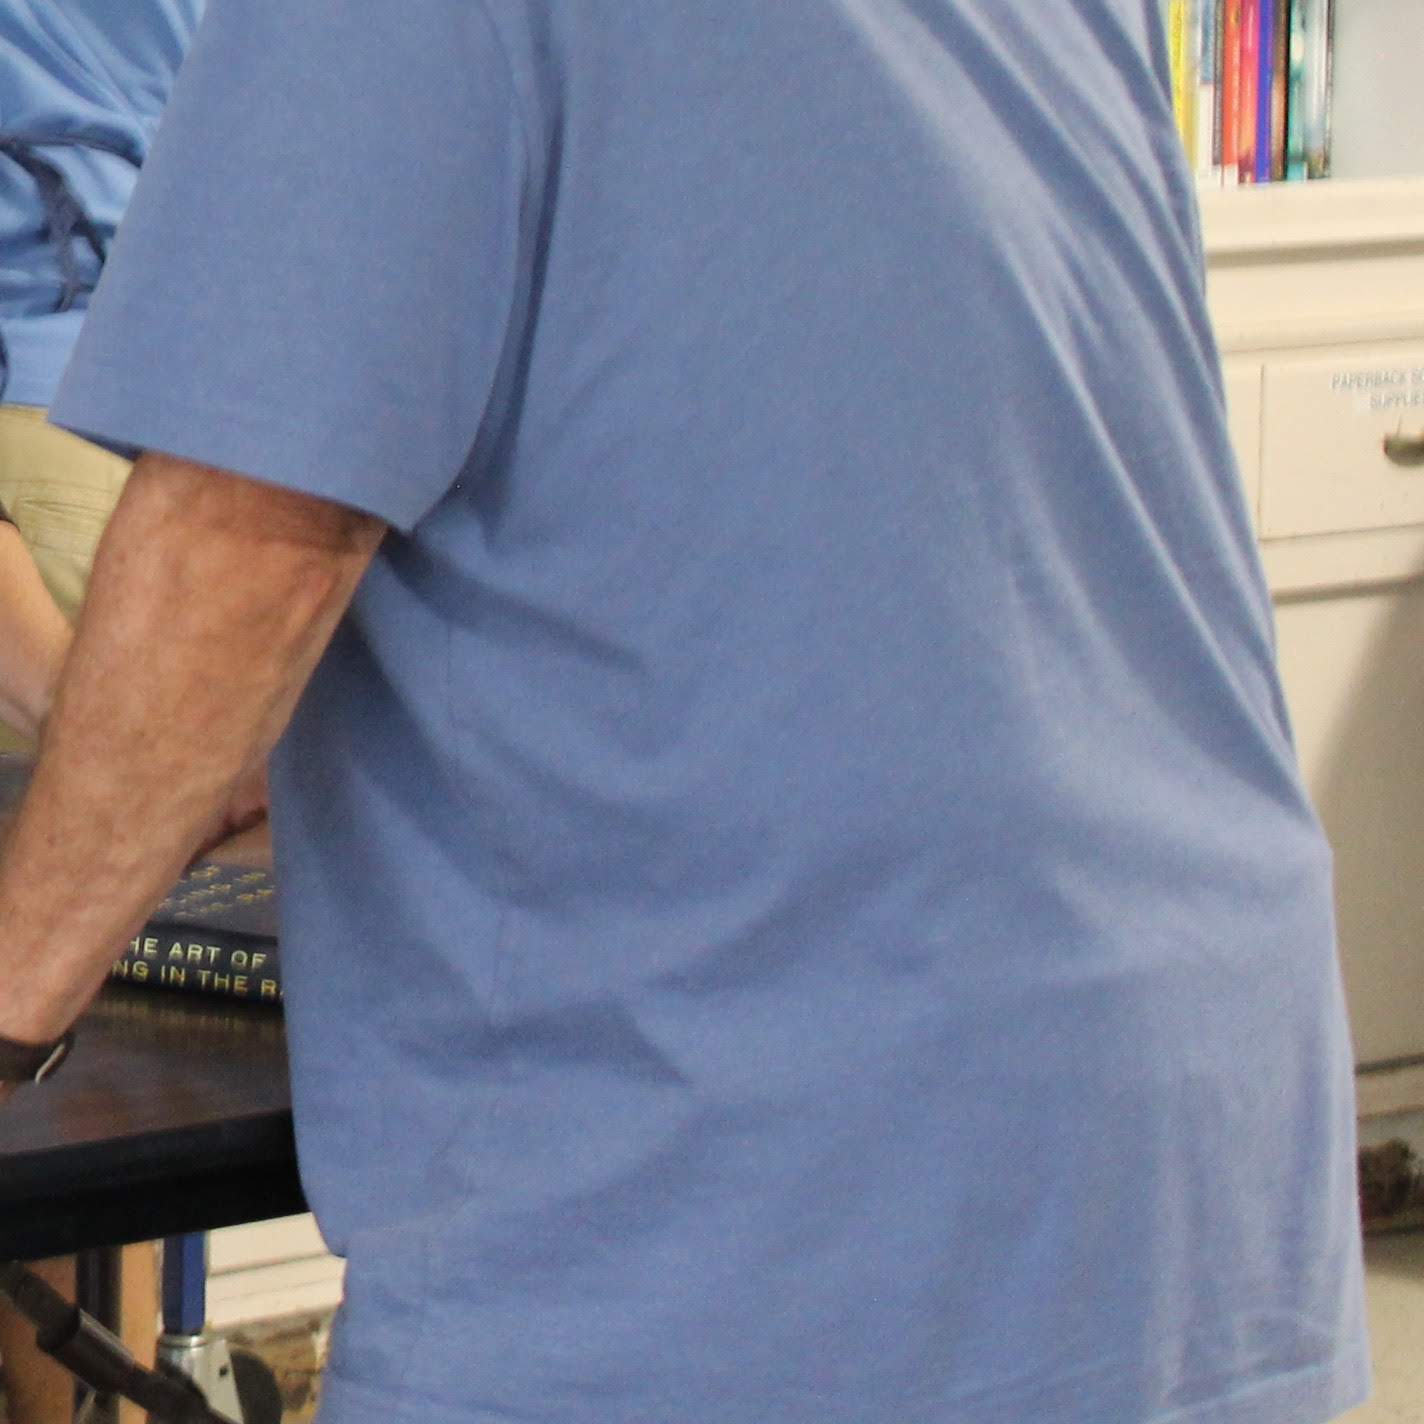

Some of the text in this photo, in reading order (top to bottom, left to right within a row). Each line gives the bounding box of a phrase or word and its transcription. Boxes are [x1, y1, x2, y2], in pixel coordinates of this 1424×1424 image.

[130, 936, 267, 969] HE ART OF
[161, 965, 249, 993] IN THE
